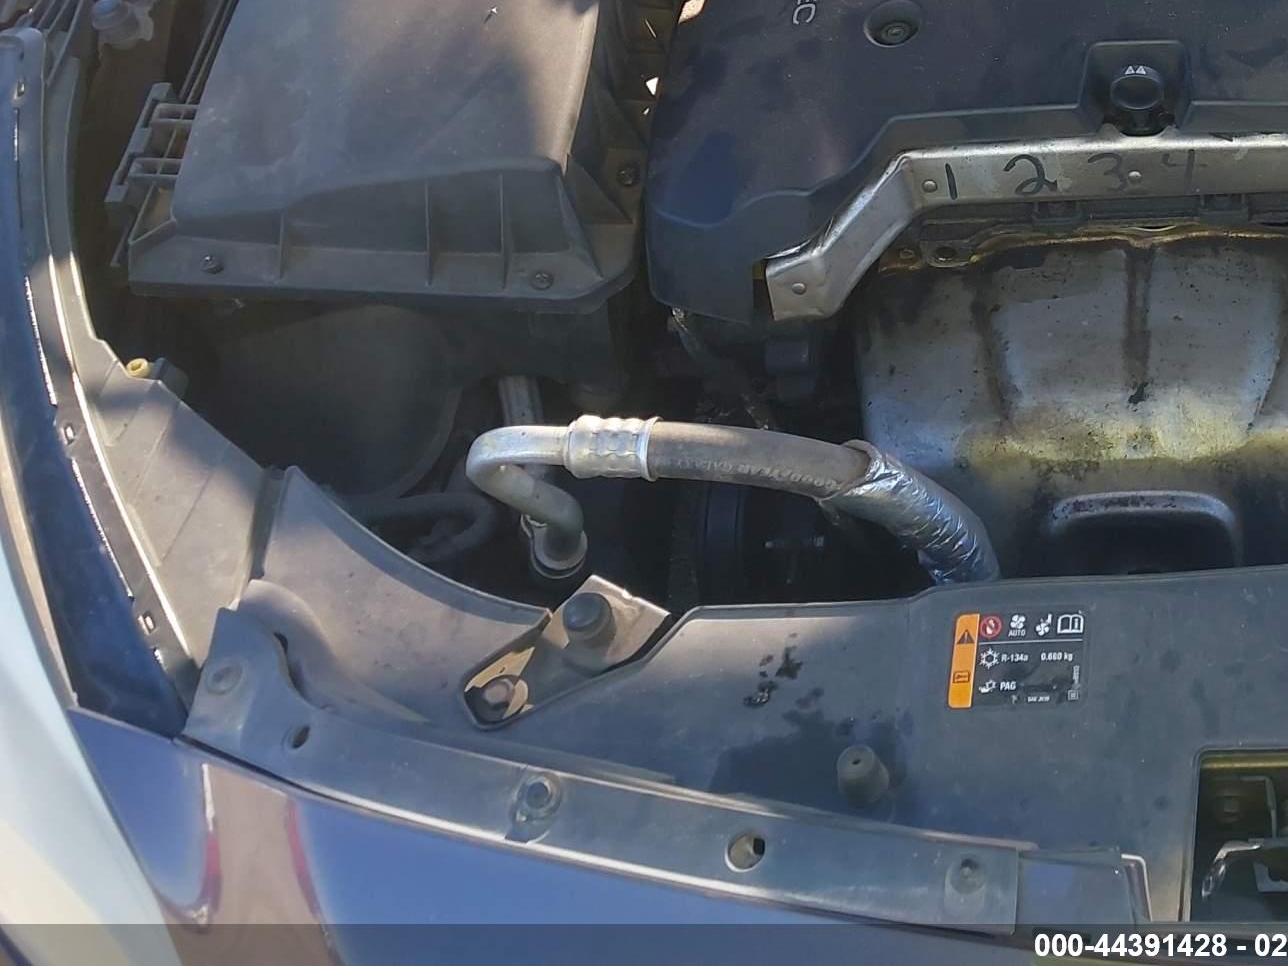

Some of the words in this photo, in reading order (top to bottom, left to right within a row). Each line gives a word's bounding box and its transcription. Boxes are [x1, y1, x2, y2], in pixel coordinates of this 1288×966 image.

[945, 163, 958, 200] 1
[1003, 153, 1058, 196] 2
[1087, 152, 1129, 193] 3
[1161, 148, 1208, 190] 4
[1008, 629, 1027, 637] AUTO
[1001, 653, 1029, 662] R-134a
[1064, 652, 1073, 662] kg
[1000, 682, 1017, 691] PAG
